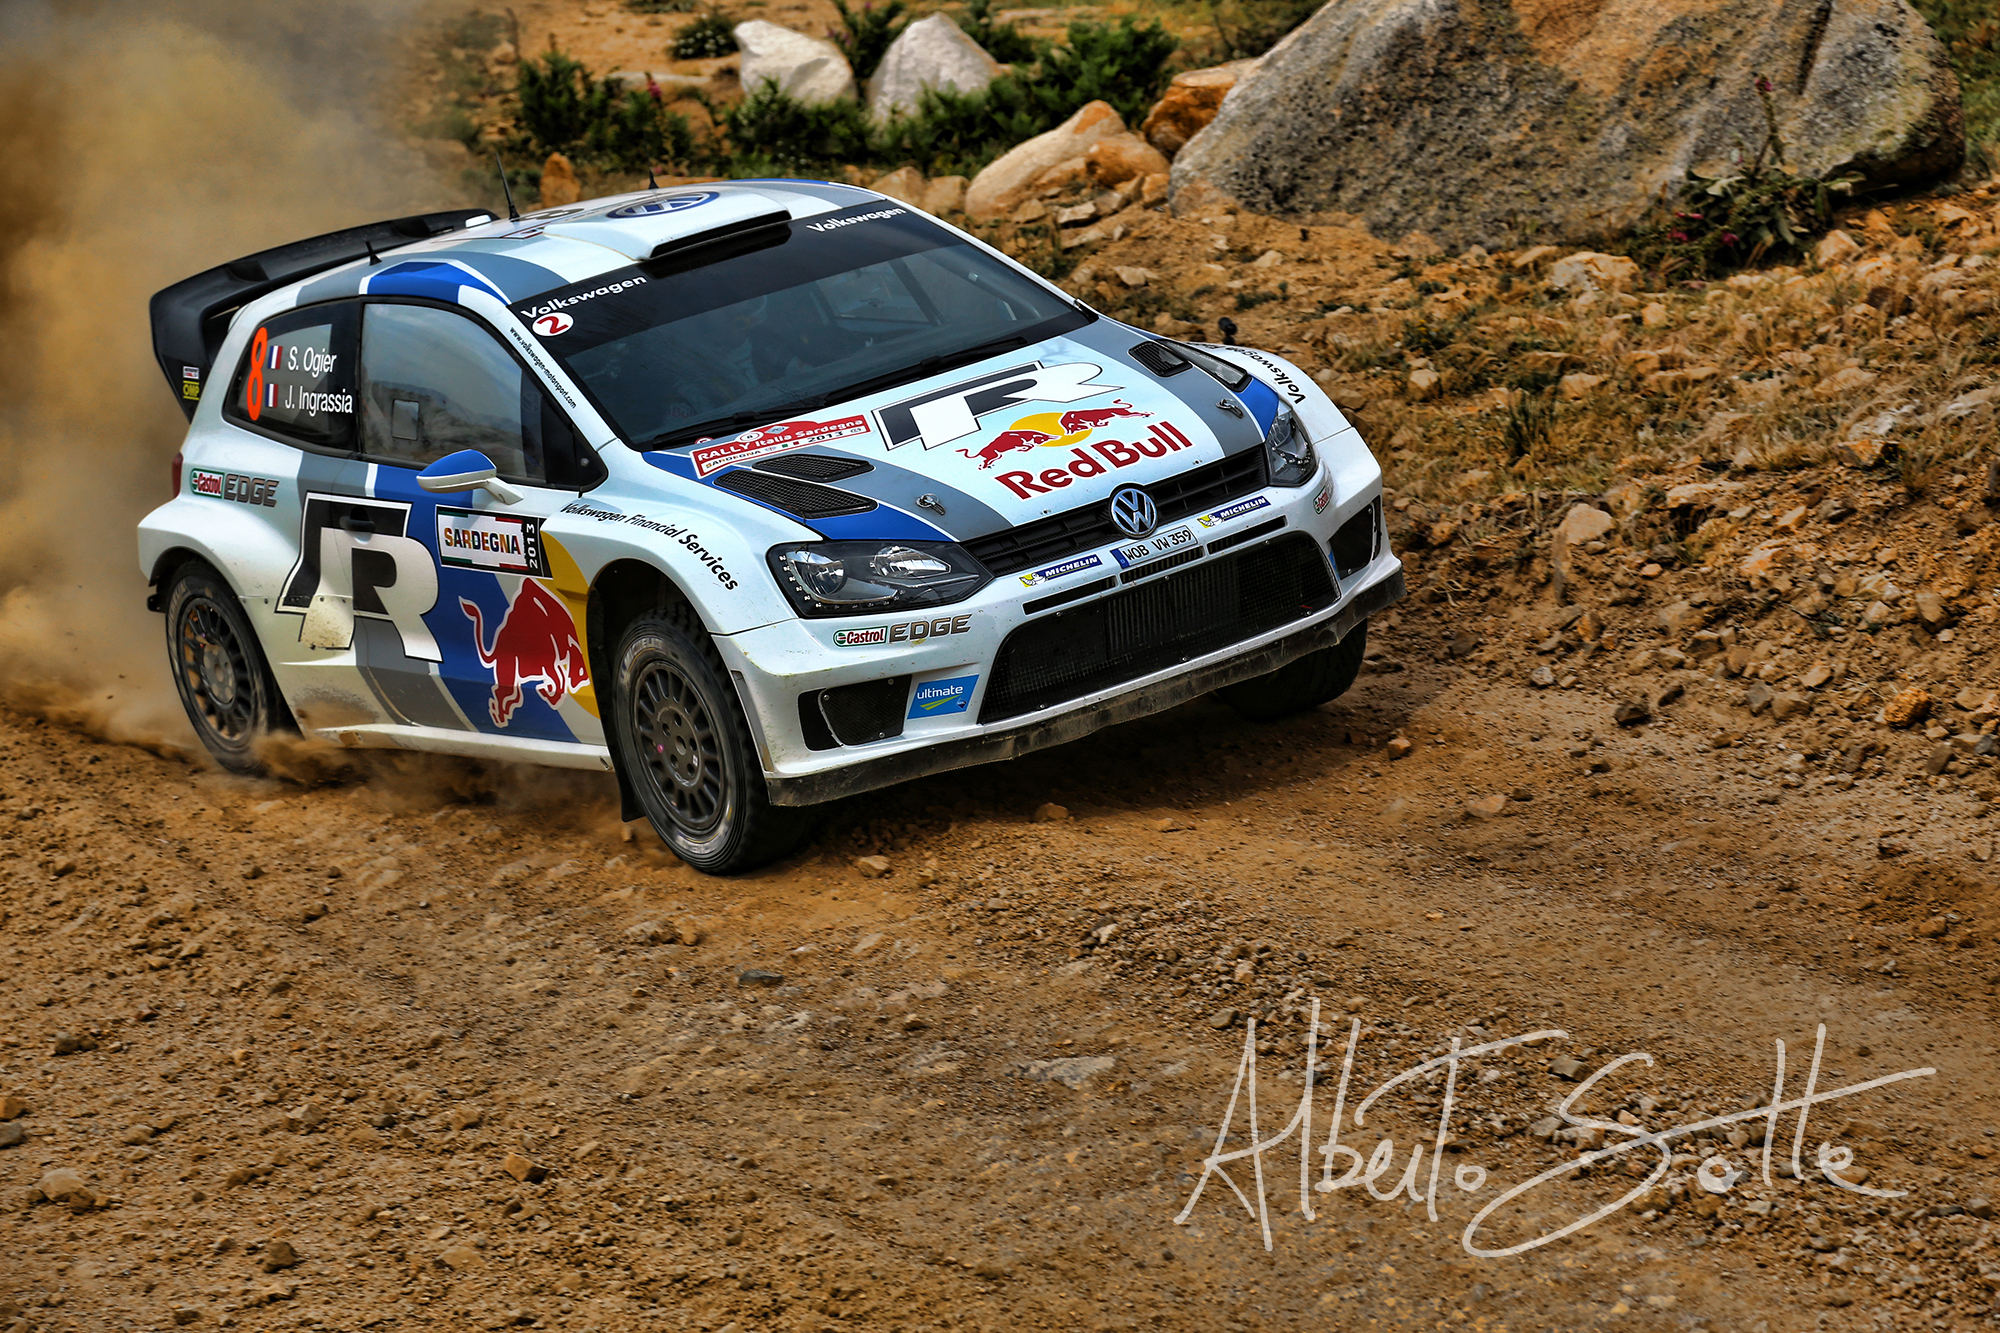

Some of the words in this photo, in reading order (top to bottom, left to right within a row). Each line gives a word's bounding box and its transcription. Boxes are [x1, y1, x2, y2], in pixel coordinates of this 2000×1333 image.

[806, 207, 906, 232] Volkswagen
[520, 276, 647, 318] Volkswagen
[536, 316, 569, 334] 2
[246, 326, 268, 421] 8
[287, 345, 299, 371] S.
[303, 346, 337, 378] Ogier
[509, 326, 577, 409] www.volkswagen-motorsport.com
[284, 384, 295, 409] J.
[298, 385, 353, 417] Ingrassia
[697, 442, 751, 461] RALLY
[755, 433, 793, 447] Italia
[795, 419, 863, 438] Sardegna
[808, 430, 844, 443] 2013
[994, 448, 1107, 500] Red
[1090, 421, 1193, 469] Bull
[197, 473, 222, 494] Castrol
[224, 473, 280, 508] EDGE
[1220, 497, 1266, 518] MICHELIN
[443, 527, 522, 556] SARDEGNA
[526, 523, 539, 569] 2013
[560, 503, 627, 523] Volkswagen
[624, 513, 688, 538] Financial
[678, 534, 739, 591] Services
[1123, 544, 1151, 561] WOB
[1152, 536, 1171, 552] VW
[1170, 529, 1192, 545] 359
[1045, 556, 1098, 577] MICHELIN
[846, 628, 885, 645] Castrol
[889, 613, 973, 644] EDGE
[916, 685, 964, 700] ultimate
